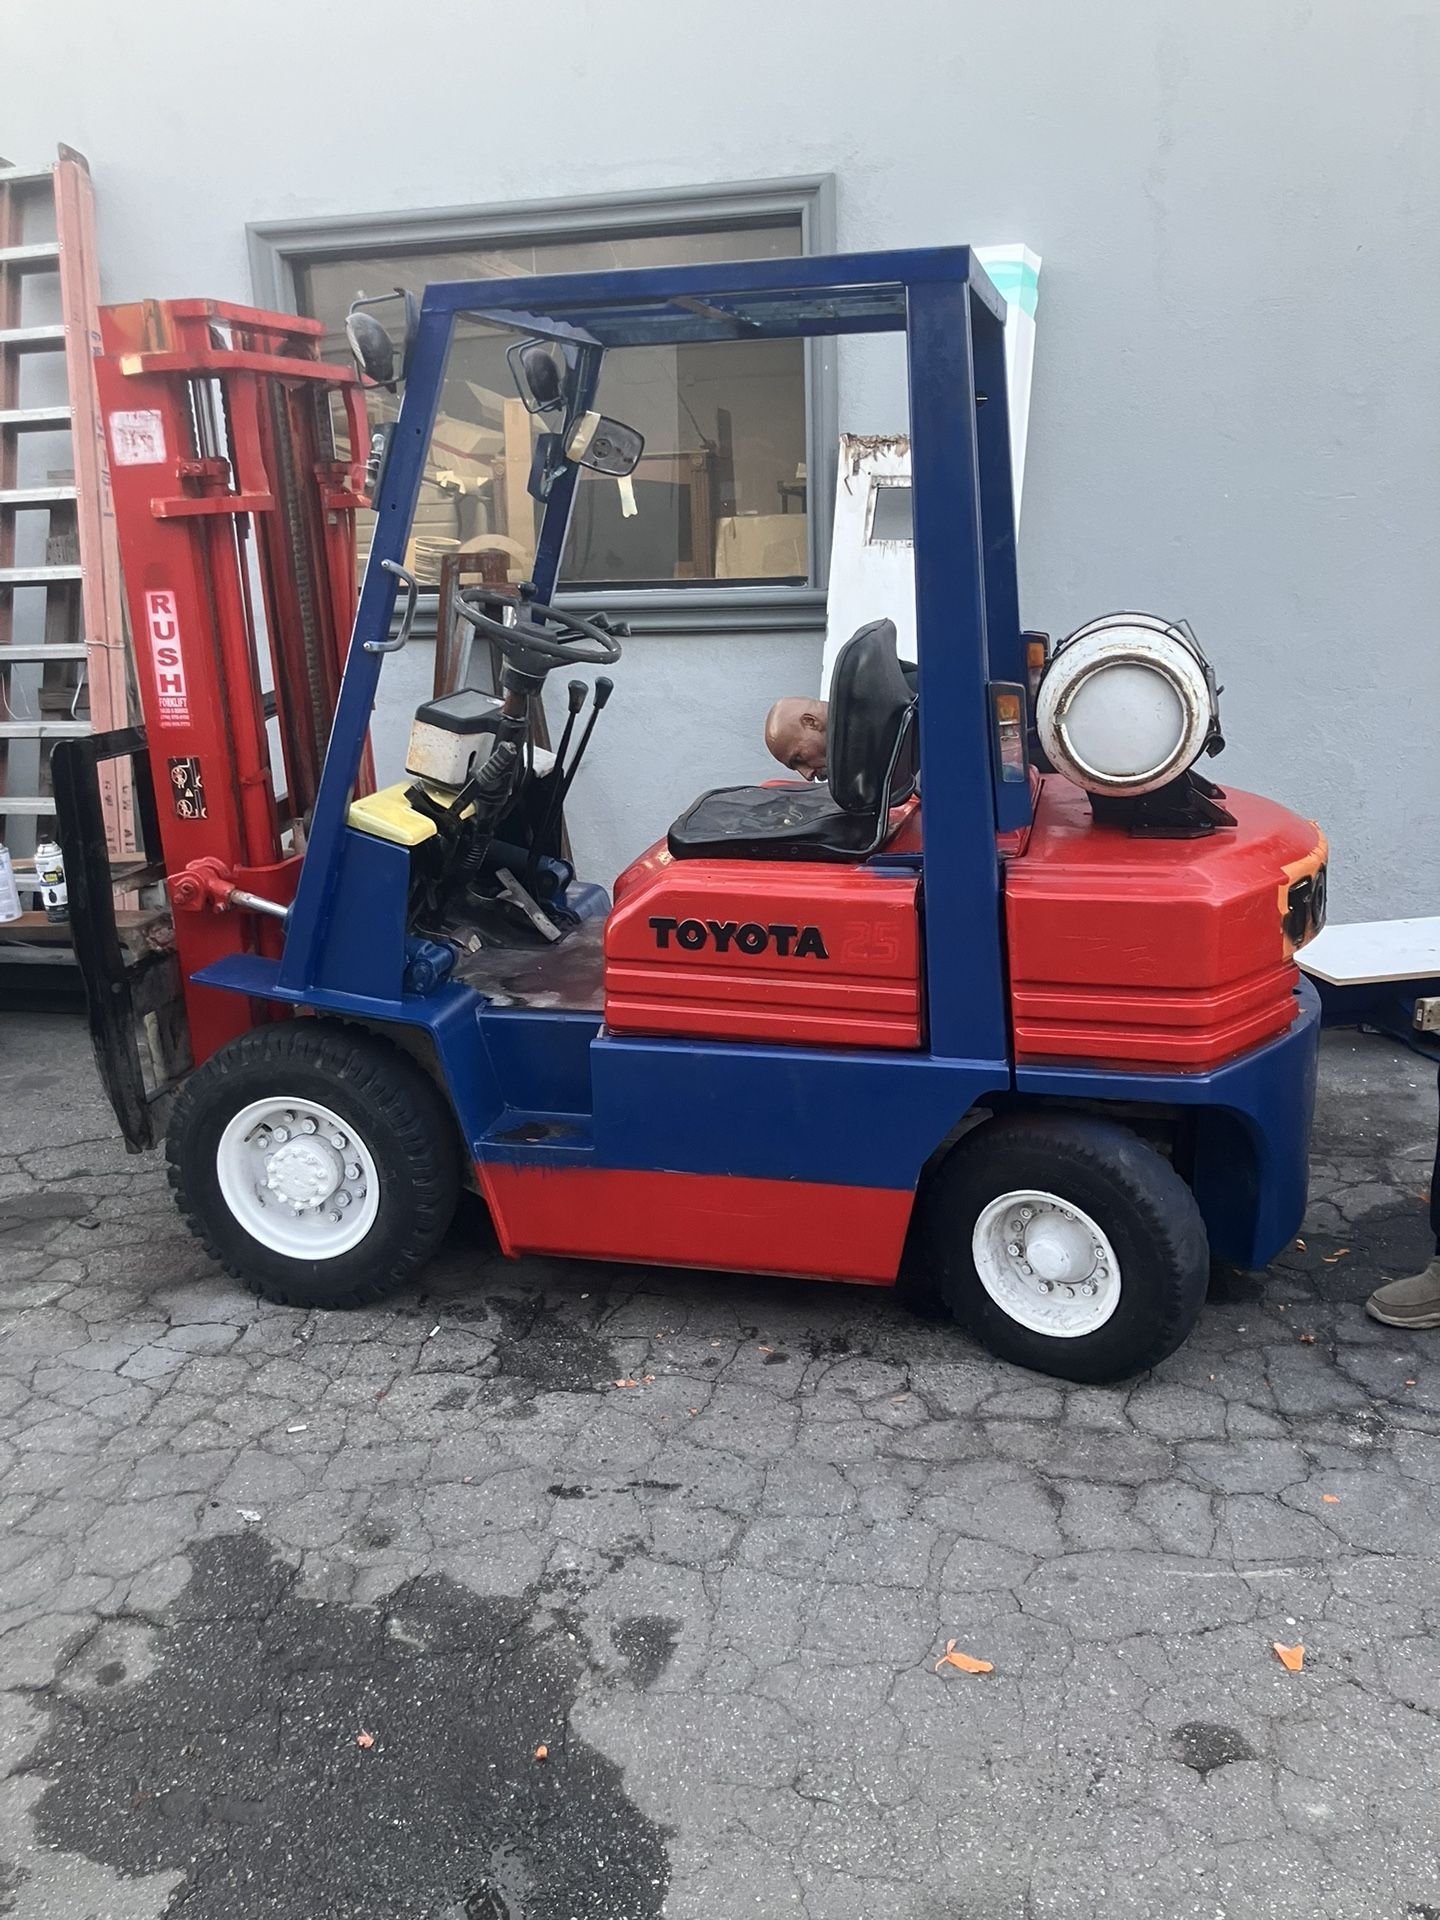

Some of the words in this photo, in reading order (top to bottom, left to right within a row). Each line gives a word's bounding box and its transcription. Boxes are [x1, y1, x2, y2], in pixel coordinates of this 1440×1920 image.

[150, 594, 183, 693] RUSH
[159, 698, 187, 707] FORKLIFT
[648, 917, 829, 960] TOYOTA
[841, 921, 899, 965] 25
